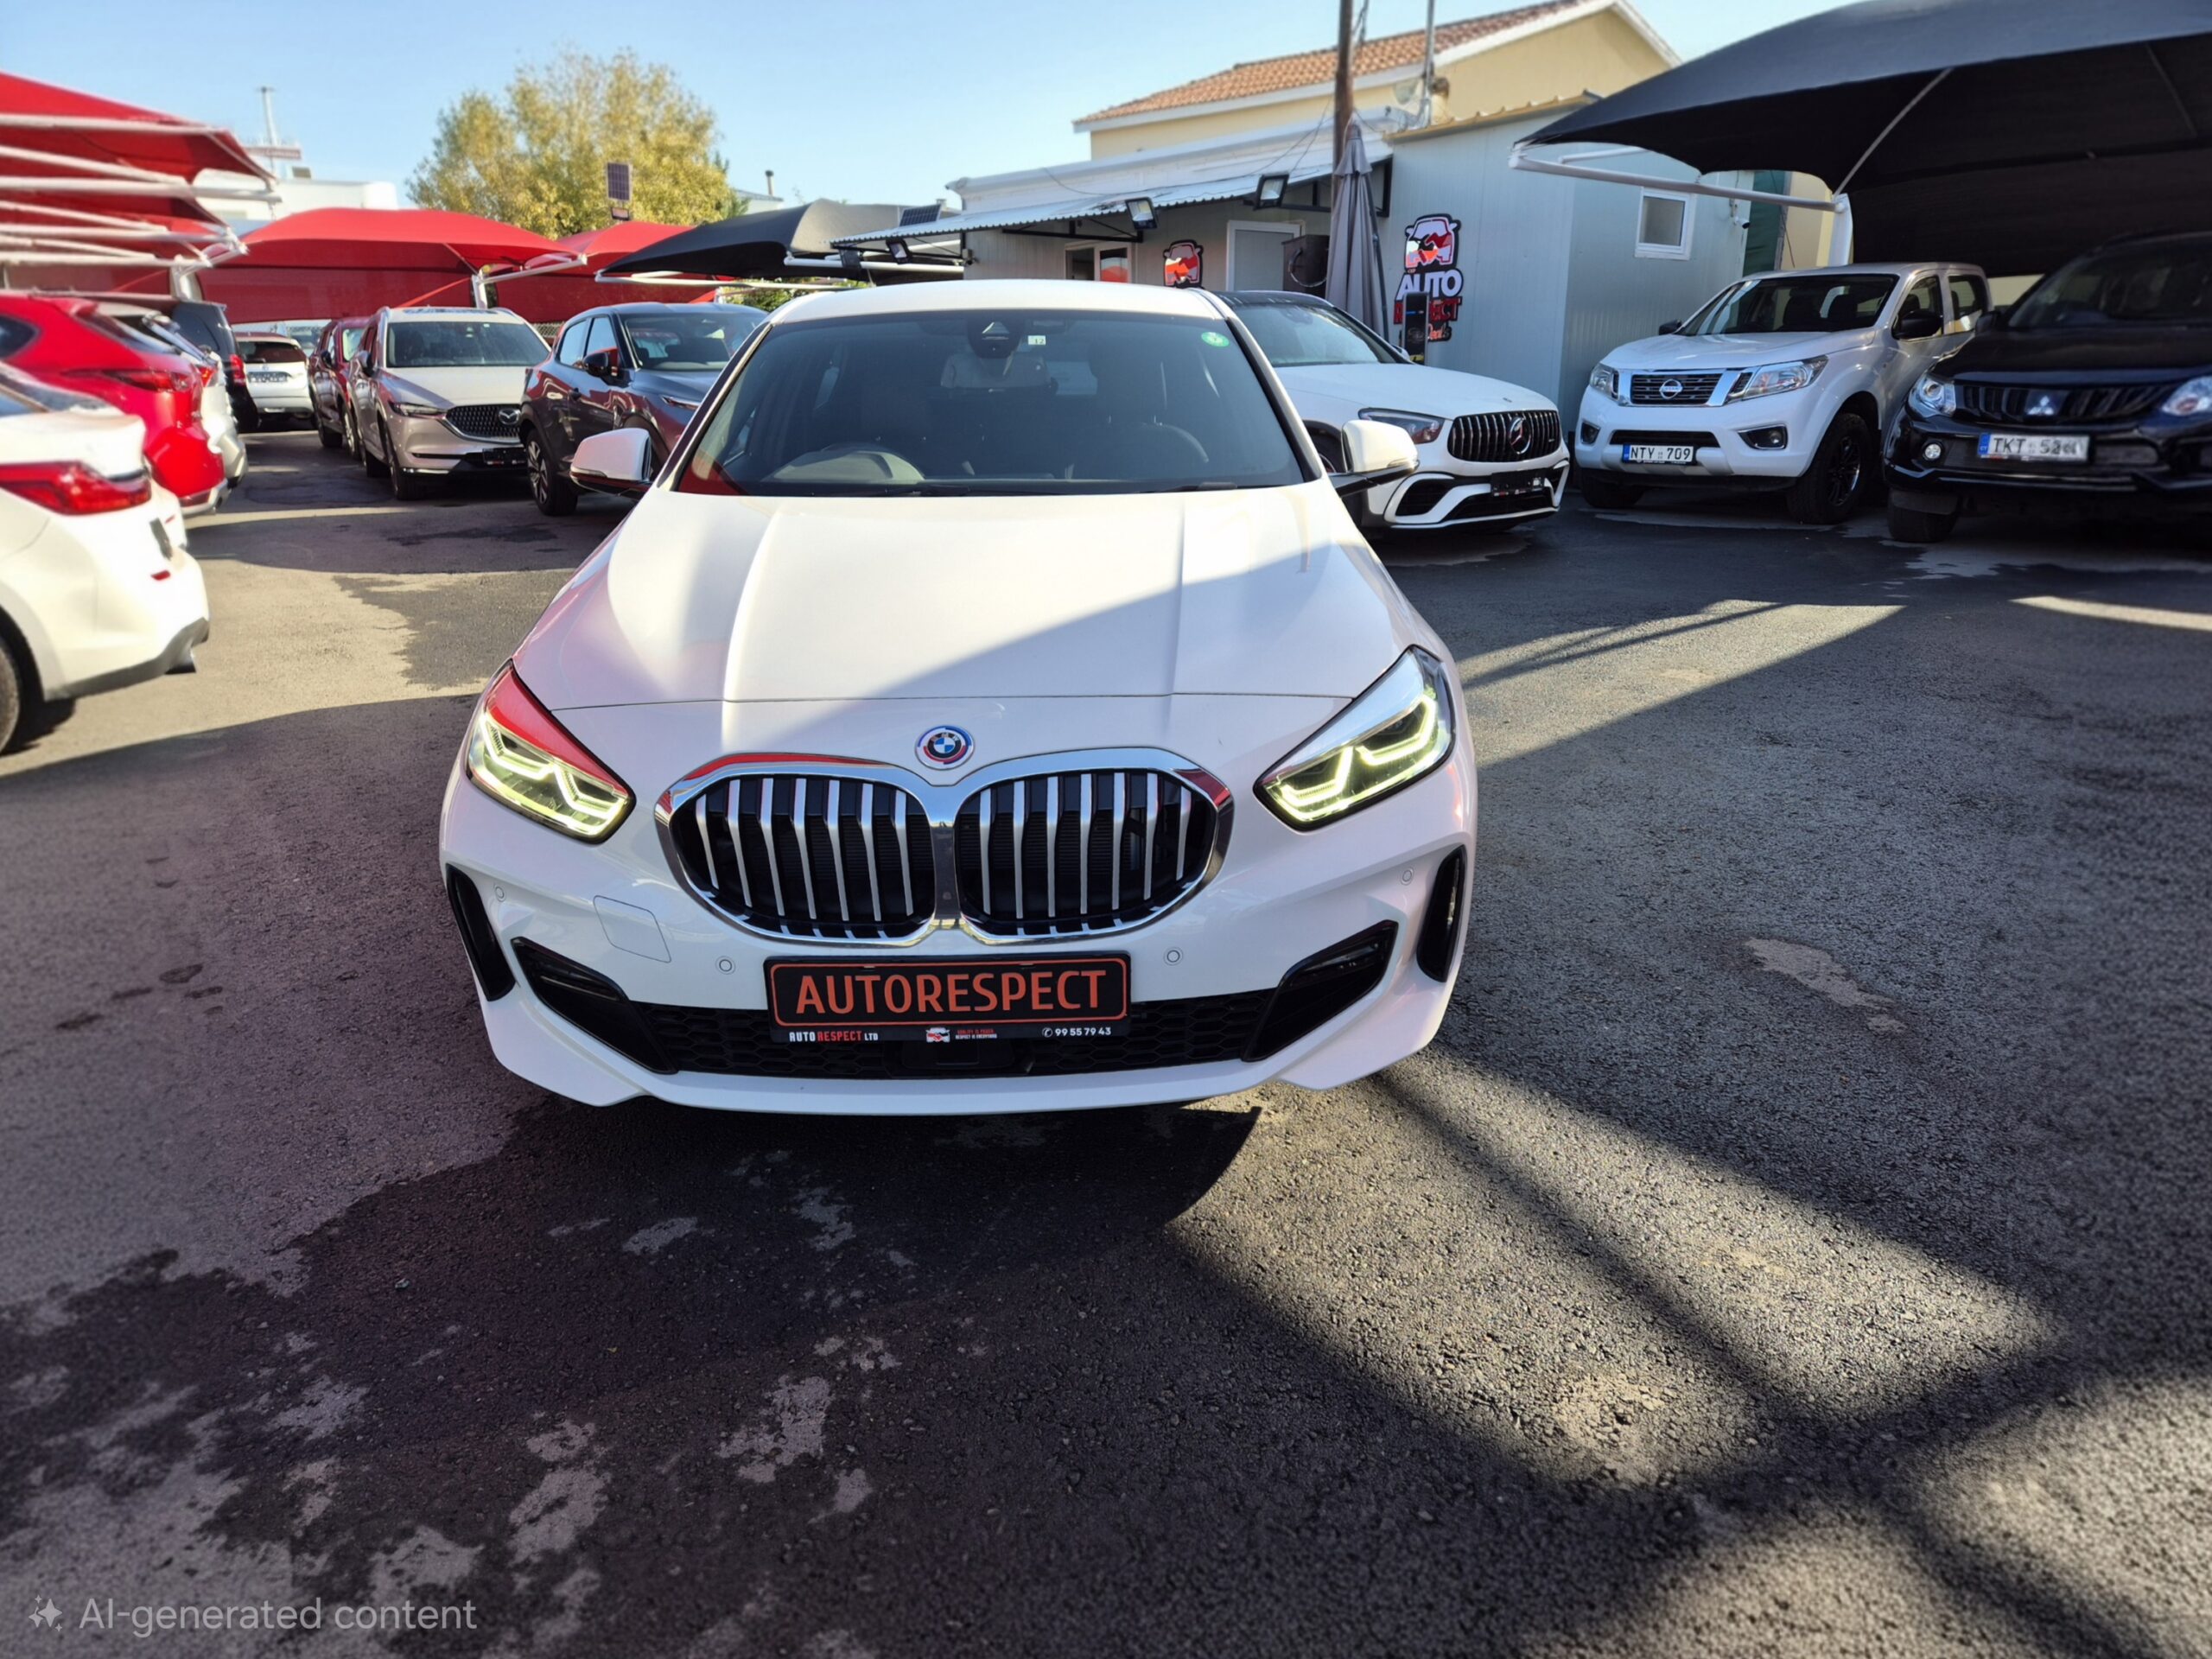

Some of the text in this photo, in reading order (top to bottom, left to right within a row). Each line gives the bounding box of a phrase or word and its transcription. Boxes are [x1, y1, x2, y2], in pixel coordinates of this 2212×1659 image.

[1396, 270, 1462, 300] AUTO
[1630, 447, 1691, 460] NTY 709
[1993, 437, 2026, 454] TKT
[795, 969, 1106, 1014] AUTORESPECT
[864, 1033, 879, 1041] LTD
